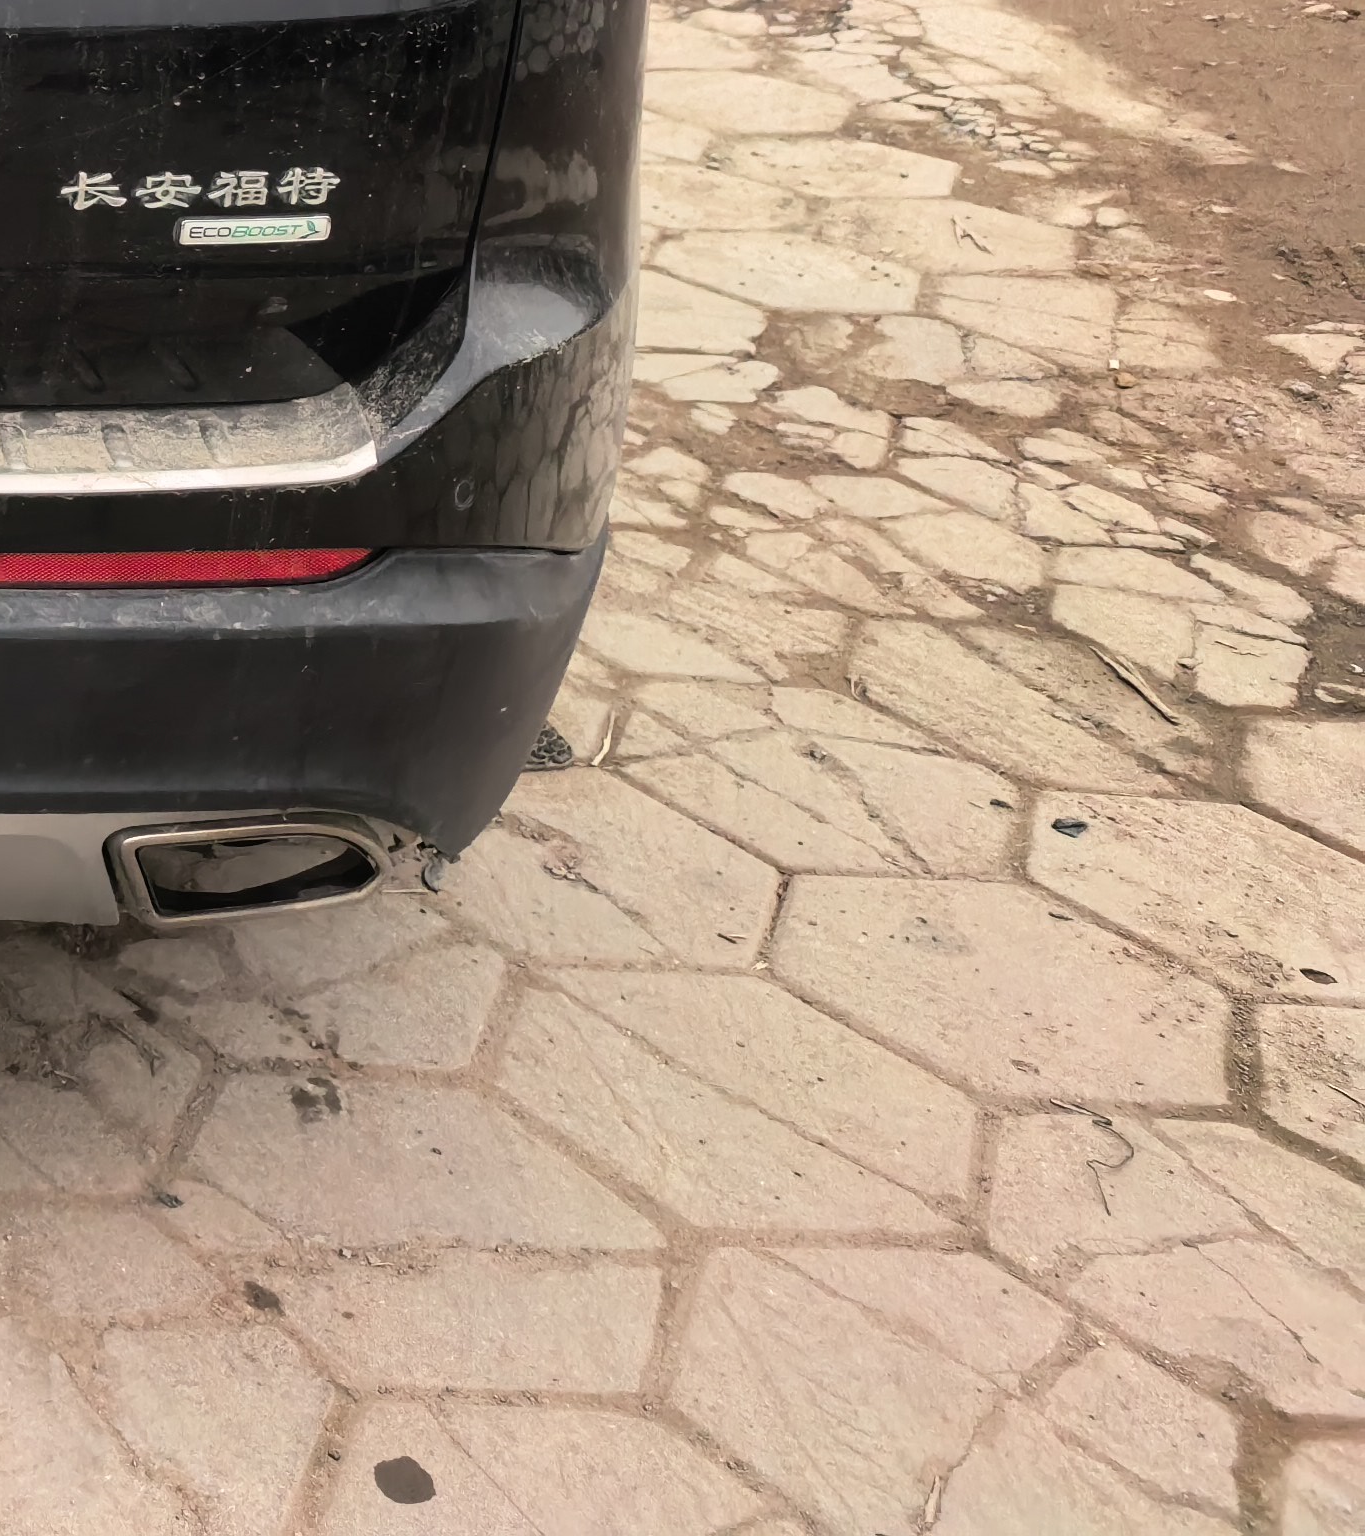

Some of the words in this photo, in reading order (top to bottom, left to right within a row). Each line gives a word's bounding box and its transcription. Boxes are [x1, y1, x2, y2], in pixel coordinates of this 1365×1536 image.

[60, 167, 341, 211] 长安福特
[188, 224, 303, 239] ECOBOOST
